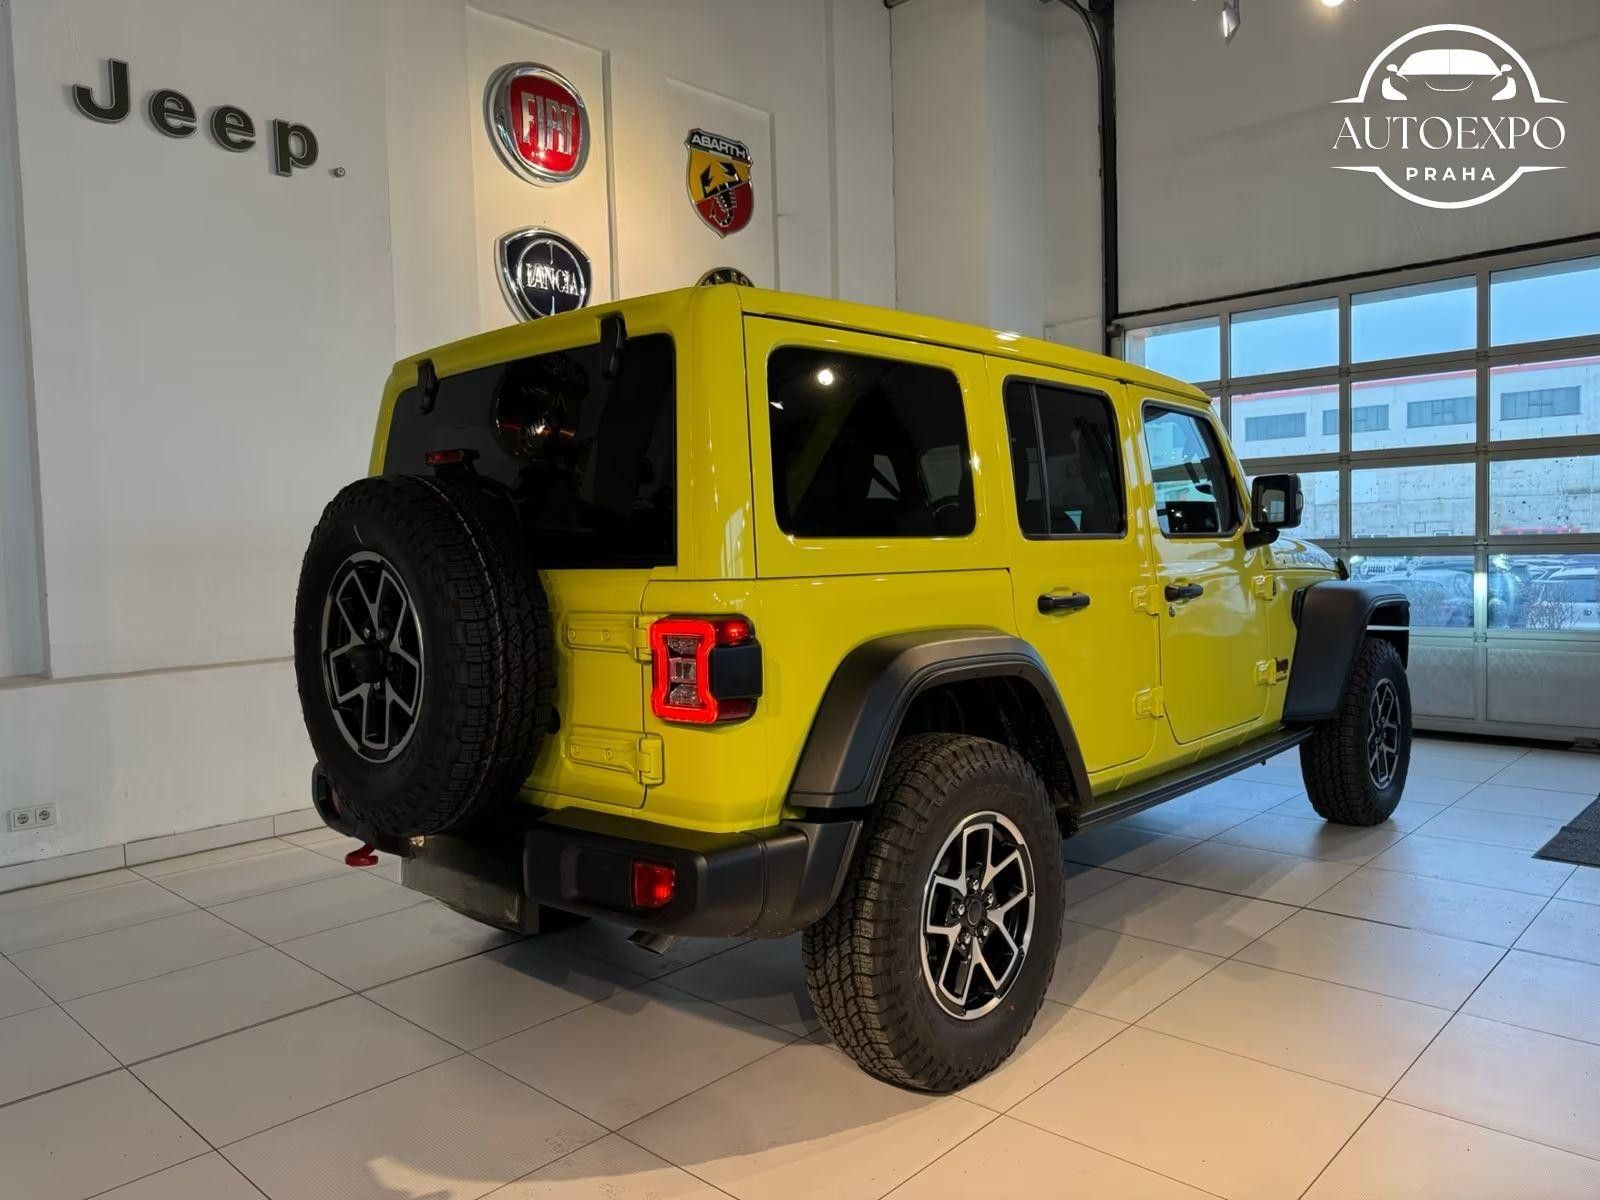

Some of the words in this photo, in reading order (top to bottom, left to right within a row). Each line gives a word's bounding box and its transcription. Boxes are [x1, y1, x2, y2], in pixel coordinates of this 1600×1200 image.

[521, 91, 575, 155] FIAT
[691, 134, 747, 159] ABARTH
[525, 263, 580, 296] LANCIA
